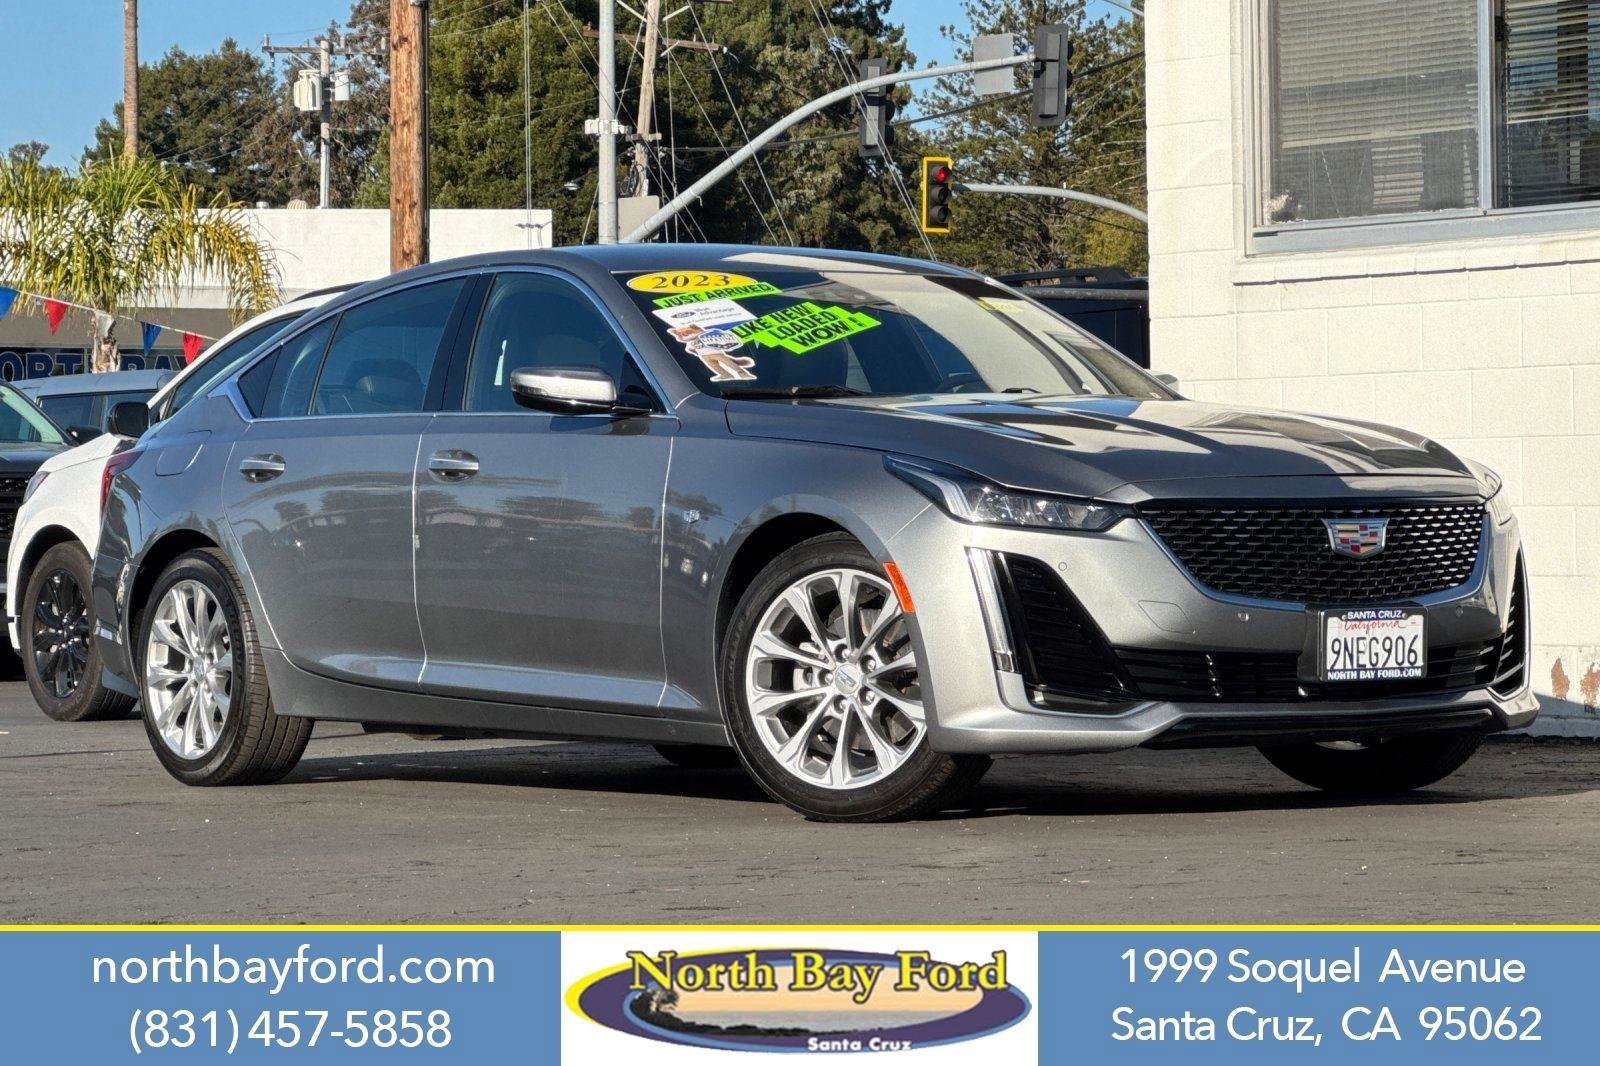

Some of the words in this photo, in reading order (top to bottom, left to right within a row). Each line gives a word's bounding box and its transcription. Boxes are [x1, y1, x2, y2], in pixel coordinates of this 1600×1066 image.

[651, 274, 731, 289] 2023
[661, 293, 702, 308] JUST
[705, 283, 774, 300] ARRIVED
[730, 317, 773, 339] LIKE
[771, 303, 814, 324] NEW
[768, 310, 839, 340] LOADED
[1347, 610, 1377, 620] SANTA
[1378, 610, 1403, 619] CRUZ
[1344, 620, 1406, 634] California
[1329, 634, 1419, 670] 9NEG906
[1327, 670, 1357, 680] NORTH
[1360, 669, 1375, 679] BAY
[1377, 668, 1422, 678] FORD.COM
